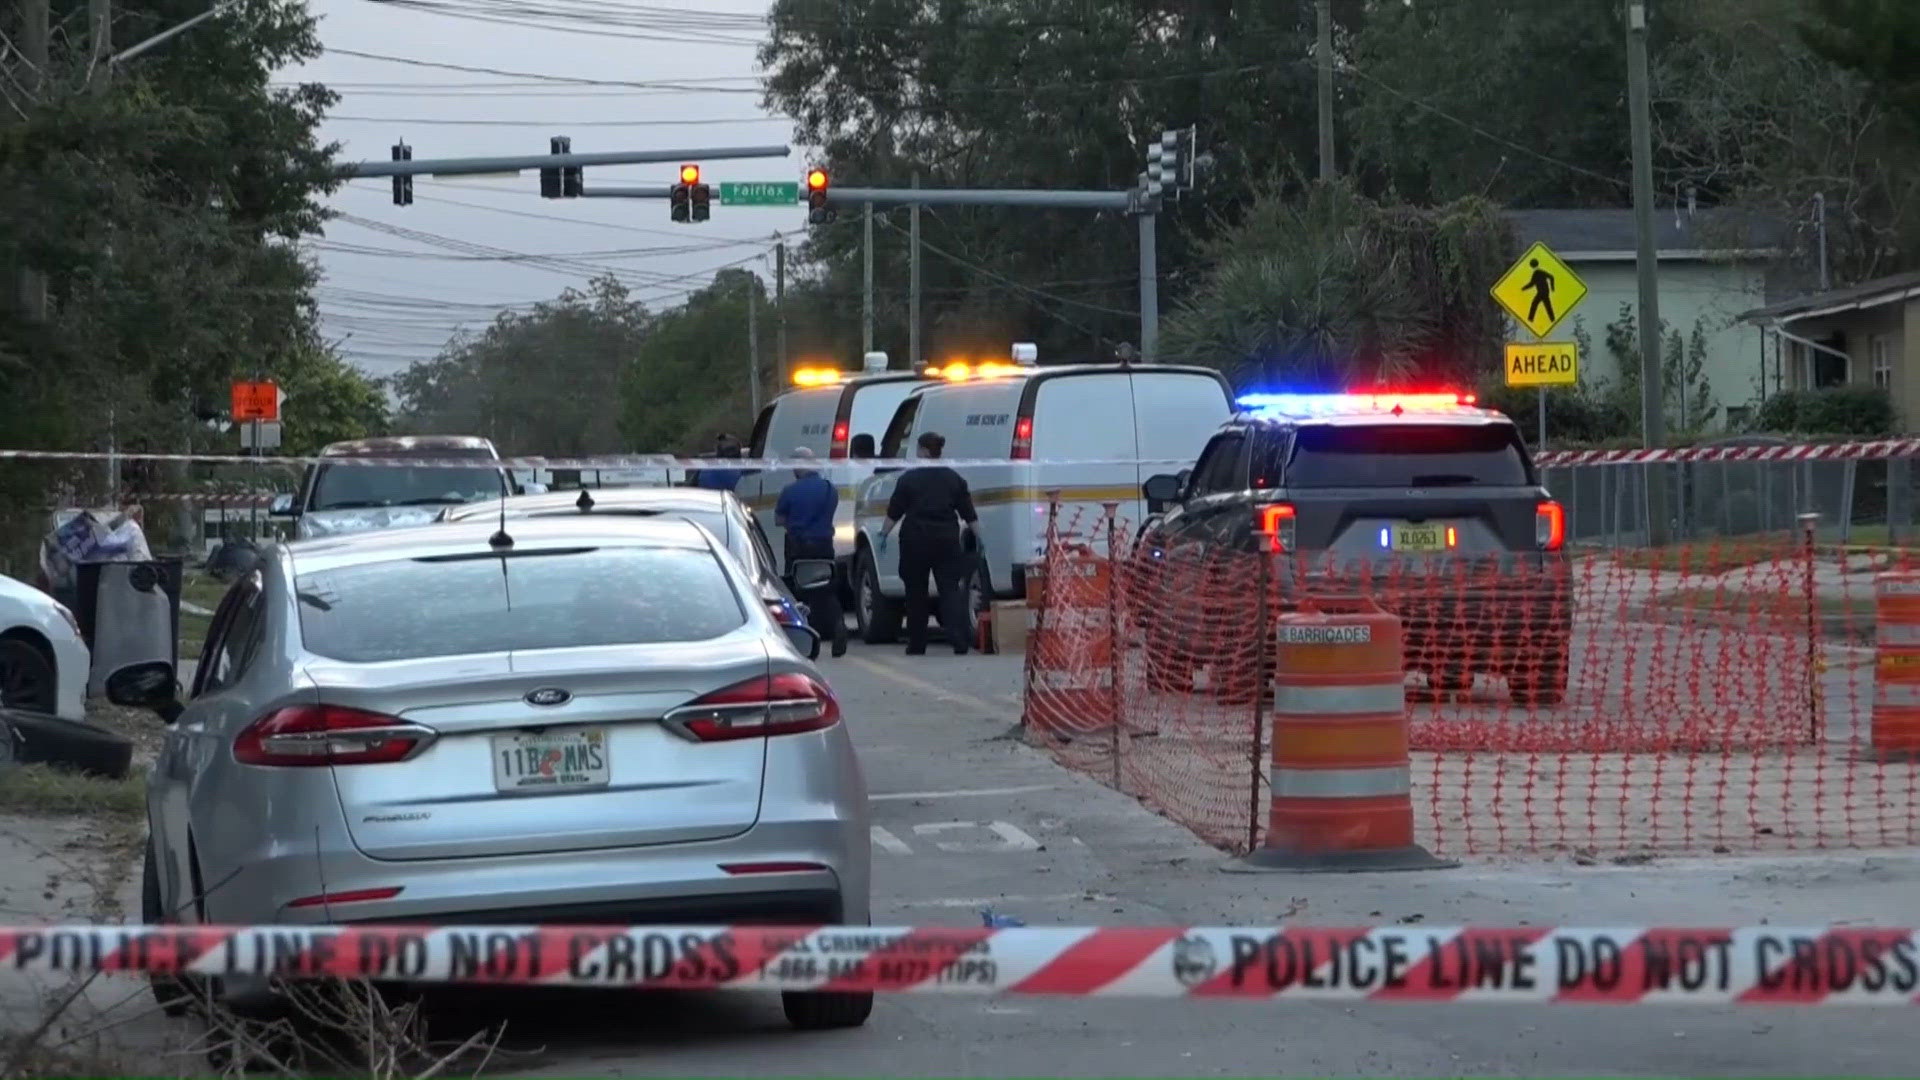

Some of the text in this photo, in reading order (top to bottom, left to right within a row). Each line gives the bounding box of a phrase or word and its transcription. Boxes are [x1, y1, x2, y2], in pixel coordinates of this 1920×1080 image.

[733, 184, 784, 197] Fairfax
[1512, 354, 1571, 374] AHEAD
[1289, 627, 1369, 642] BARRICADES
[502, 743, 603, 777] 11B MMS
[15, 932, 739, 981] POLICE LINE DO NOT CROSS
[1230, 935, 1919, 991] POLICE LINE DO NOT CROSS
